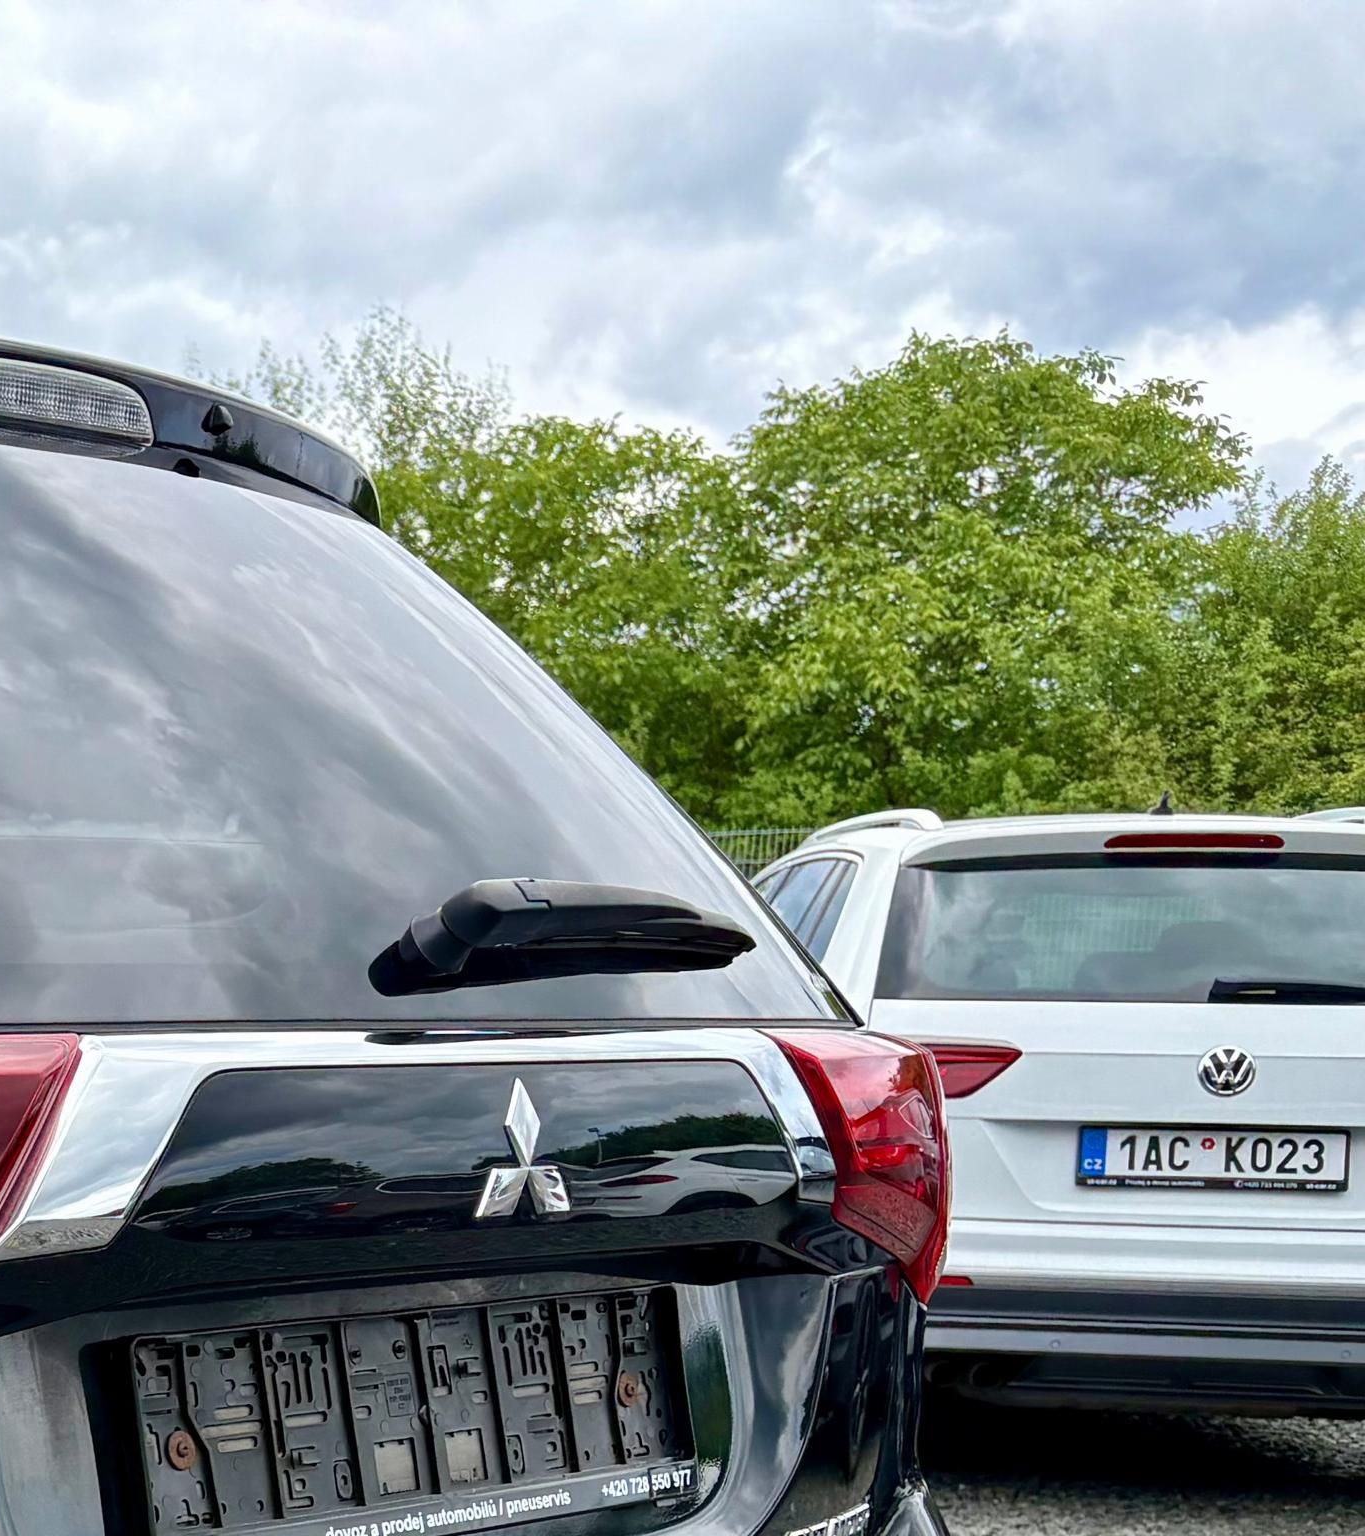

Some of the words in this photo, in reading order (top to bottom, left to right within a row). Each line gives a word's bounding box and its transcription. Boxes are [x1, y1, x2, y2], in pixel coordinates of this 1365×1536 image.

[1083, 1159, 1102, 1170] CZ
[1119, 1135, 1190, 1171] 1AC
[1224, 1136, 1326, 1175] K023
[601, 1479, 629, 1497] +420
[629, 1476, 649, 1495] 728
[651, 1472, 671, 1491] 550
[672, 1469, 691, 1488] 977
[371, 1523, 379, 1536] a
[426, 1499, 498, 1528] automobilů
[499, 1498, 503, 1515] /
[506, 1489, 572, 1518] pneuservis
